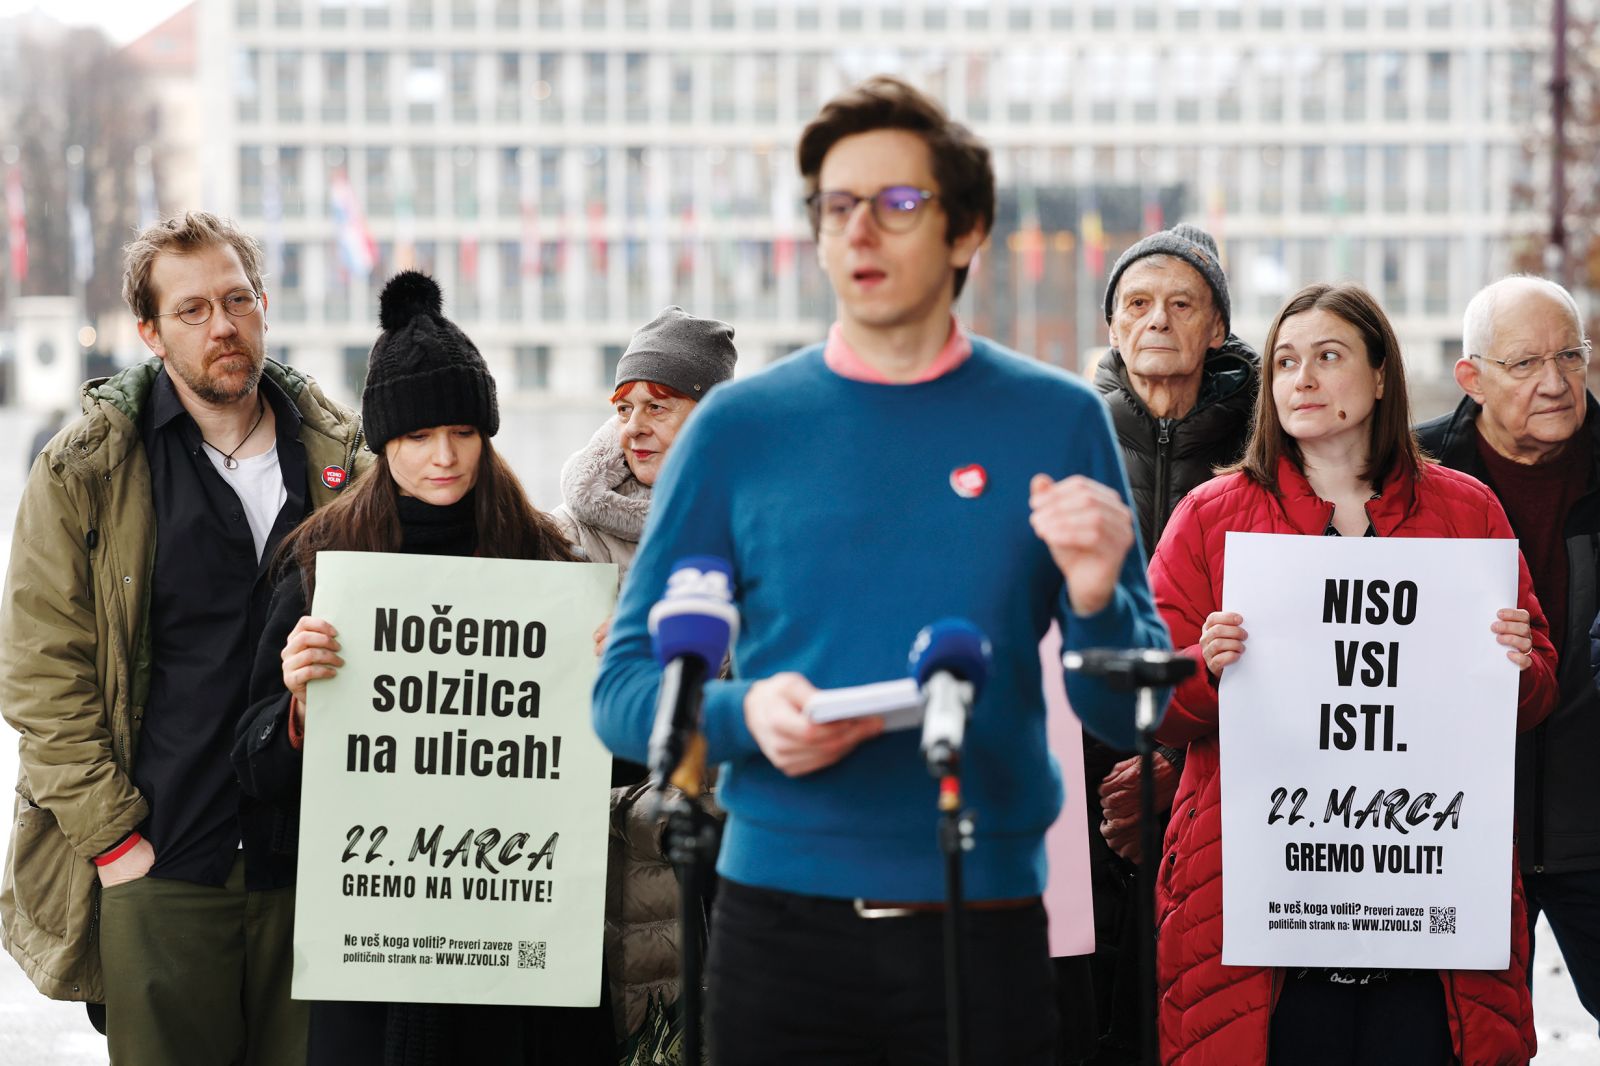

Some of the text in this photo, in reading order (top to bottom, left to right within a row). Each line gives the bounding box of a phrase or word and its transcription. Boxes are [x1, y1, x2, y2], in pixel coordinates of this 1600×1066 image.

[1323, 579, 1418, 625] NISO
[374, 605, 546, 658] Nočemo
[1335, 640, 1399, 687] VSI
[373, 669, 540, 718] solzilca
[1320, 704, 1407, 751] ISTI.
[347, 729, 561, 779] na ulicah!
[1268, 786, 1464, 834] 22. MARCA
[342, 825, 559, 874] 22. MARCA
[1286, 843, 1443, 874] GREMO VOLIT!
[343, 874, 552, 902] GREMO NA VOLITVE!
[1269, 902, 1281, 913] Ne
[1304, 902, 1327, 916] koga
[1330, 903, 1361, 915] voliti?
[1364, 906, 1393, 915] Preveri
[1396, 908, 1424, 916] zaveze
[345, 934, 357, 946] Ne
[383, 936, 409, 949] koga
[413, 936, 446, 948] voliti?
[449, 939, 480, 949] Preveri
[483, 942, 512, 950] zaveze
[1269, 919, 1421, 932] političnih strank na: WWW.IZVOLI.SI
[344, 952, 509, 966] političnih strank na: WWW.IZVOLI.SI
